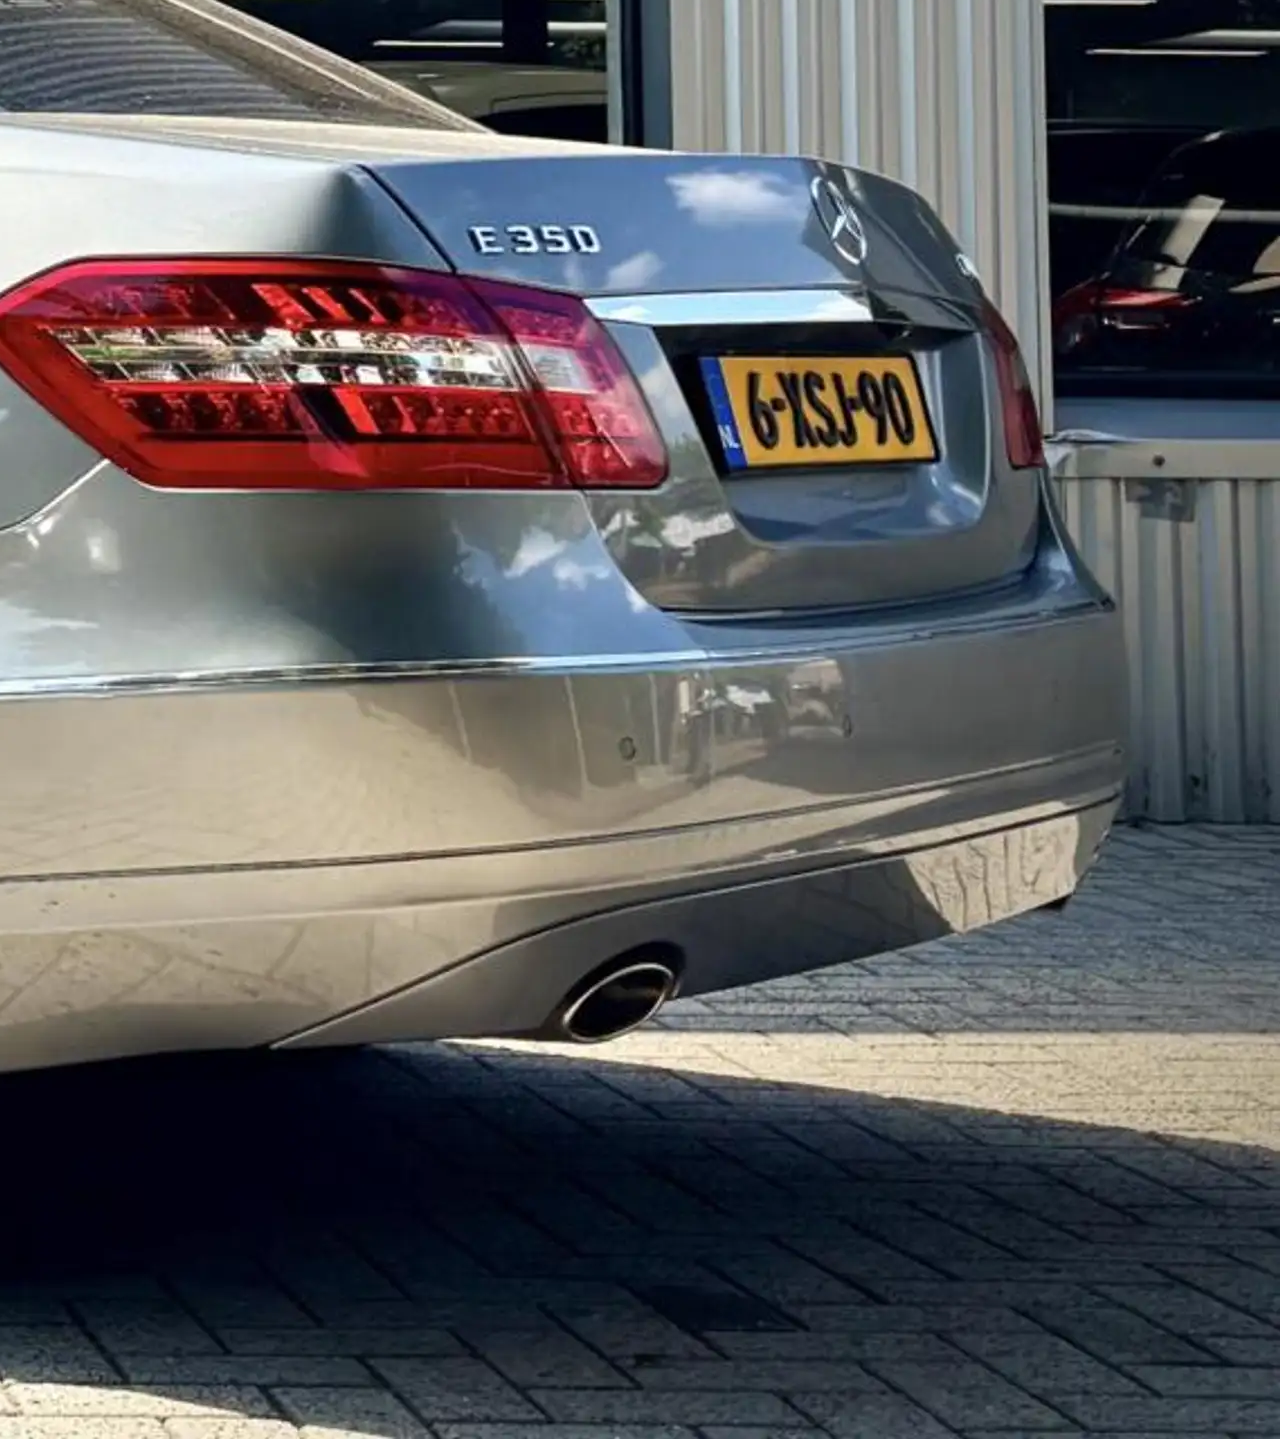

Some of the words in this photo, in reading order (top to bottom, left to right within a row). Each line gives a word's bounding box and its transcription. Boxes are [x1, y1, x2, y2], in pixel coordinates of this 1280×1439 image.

[469, 226, 505, 254] E
[506, 225, 602, 254] 350
[746, 370, 916, 450] 6-XSJ-90
[717, 423, 742, 450] NL
